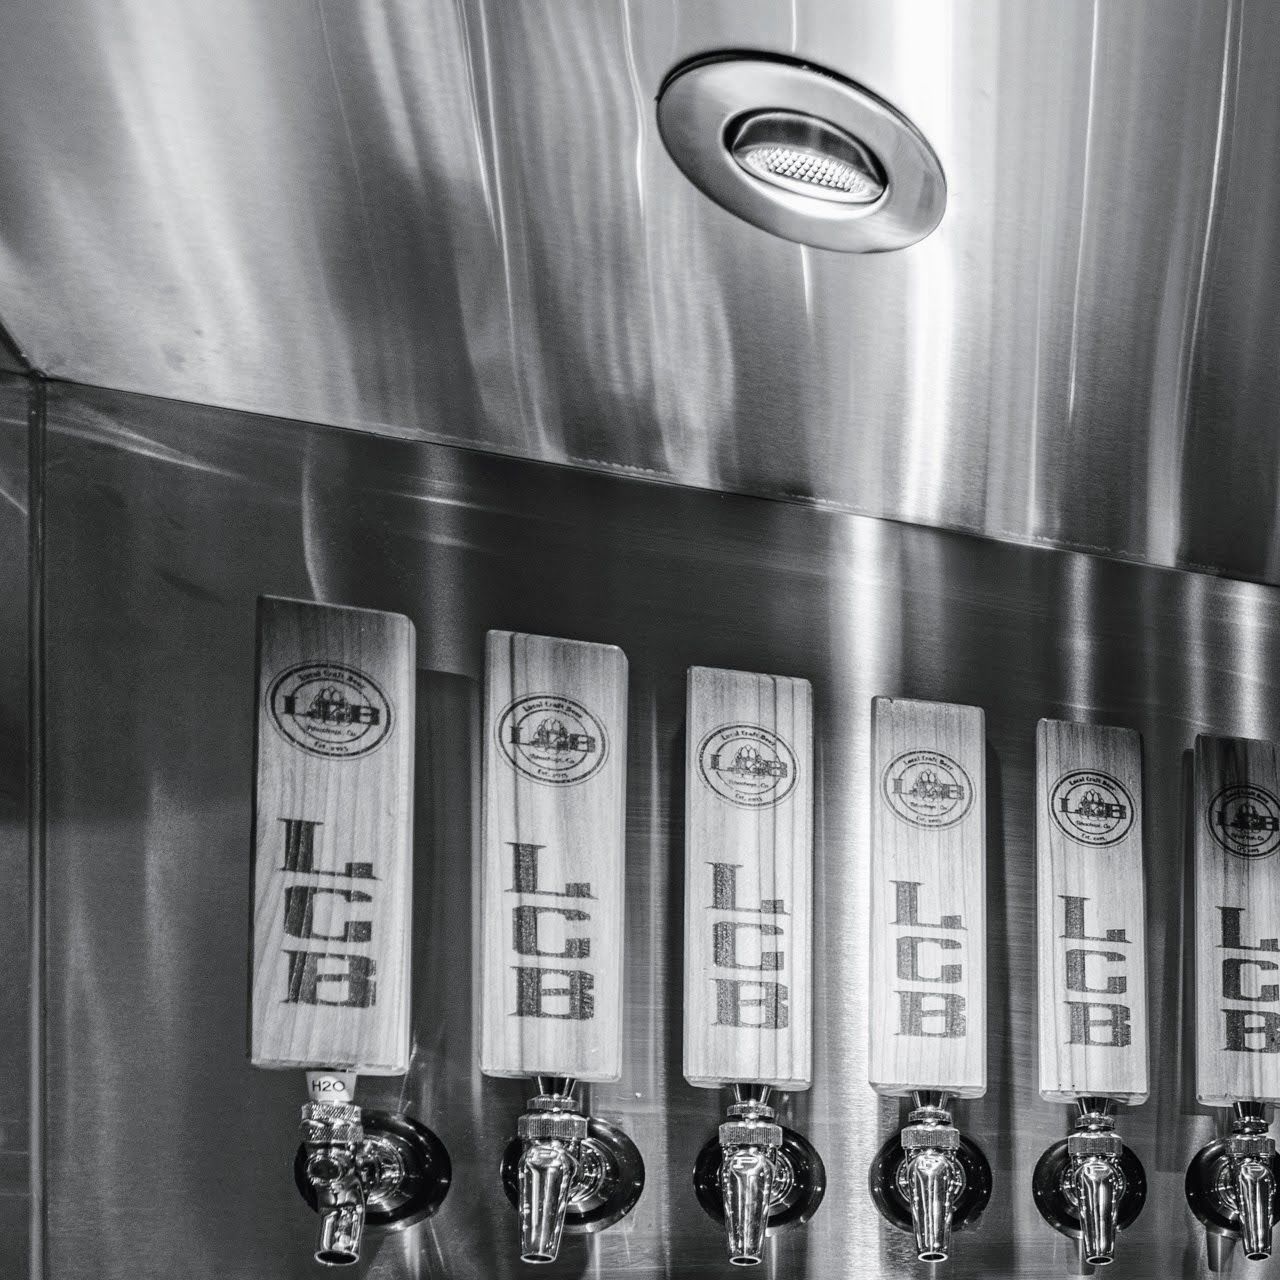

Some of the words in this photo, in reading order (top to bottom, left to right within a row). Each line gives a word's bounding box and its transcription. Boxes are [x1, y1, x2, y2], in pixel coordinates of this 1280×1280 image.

[277, 818, 382, 1008] LCB
[503, 842, 598, 1020] LCB
[706, 862, 790, 1029] LCB
[888, 880, 968, 1039] LCB
[1057, 894, 1133, 1048] LCB
[312, 1080, 345, 1092] H2O
